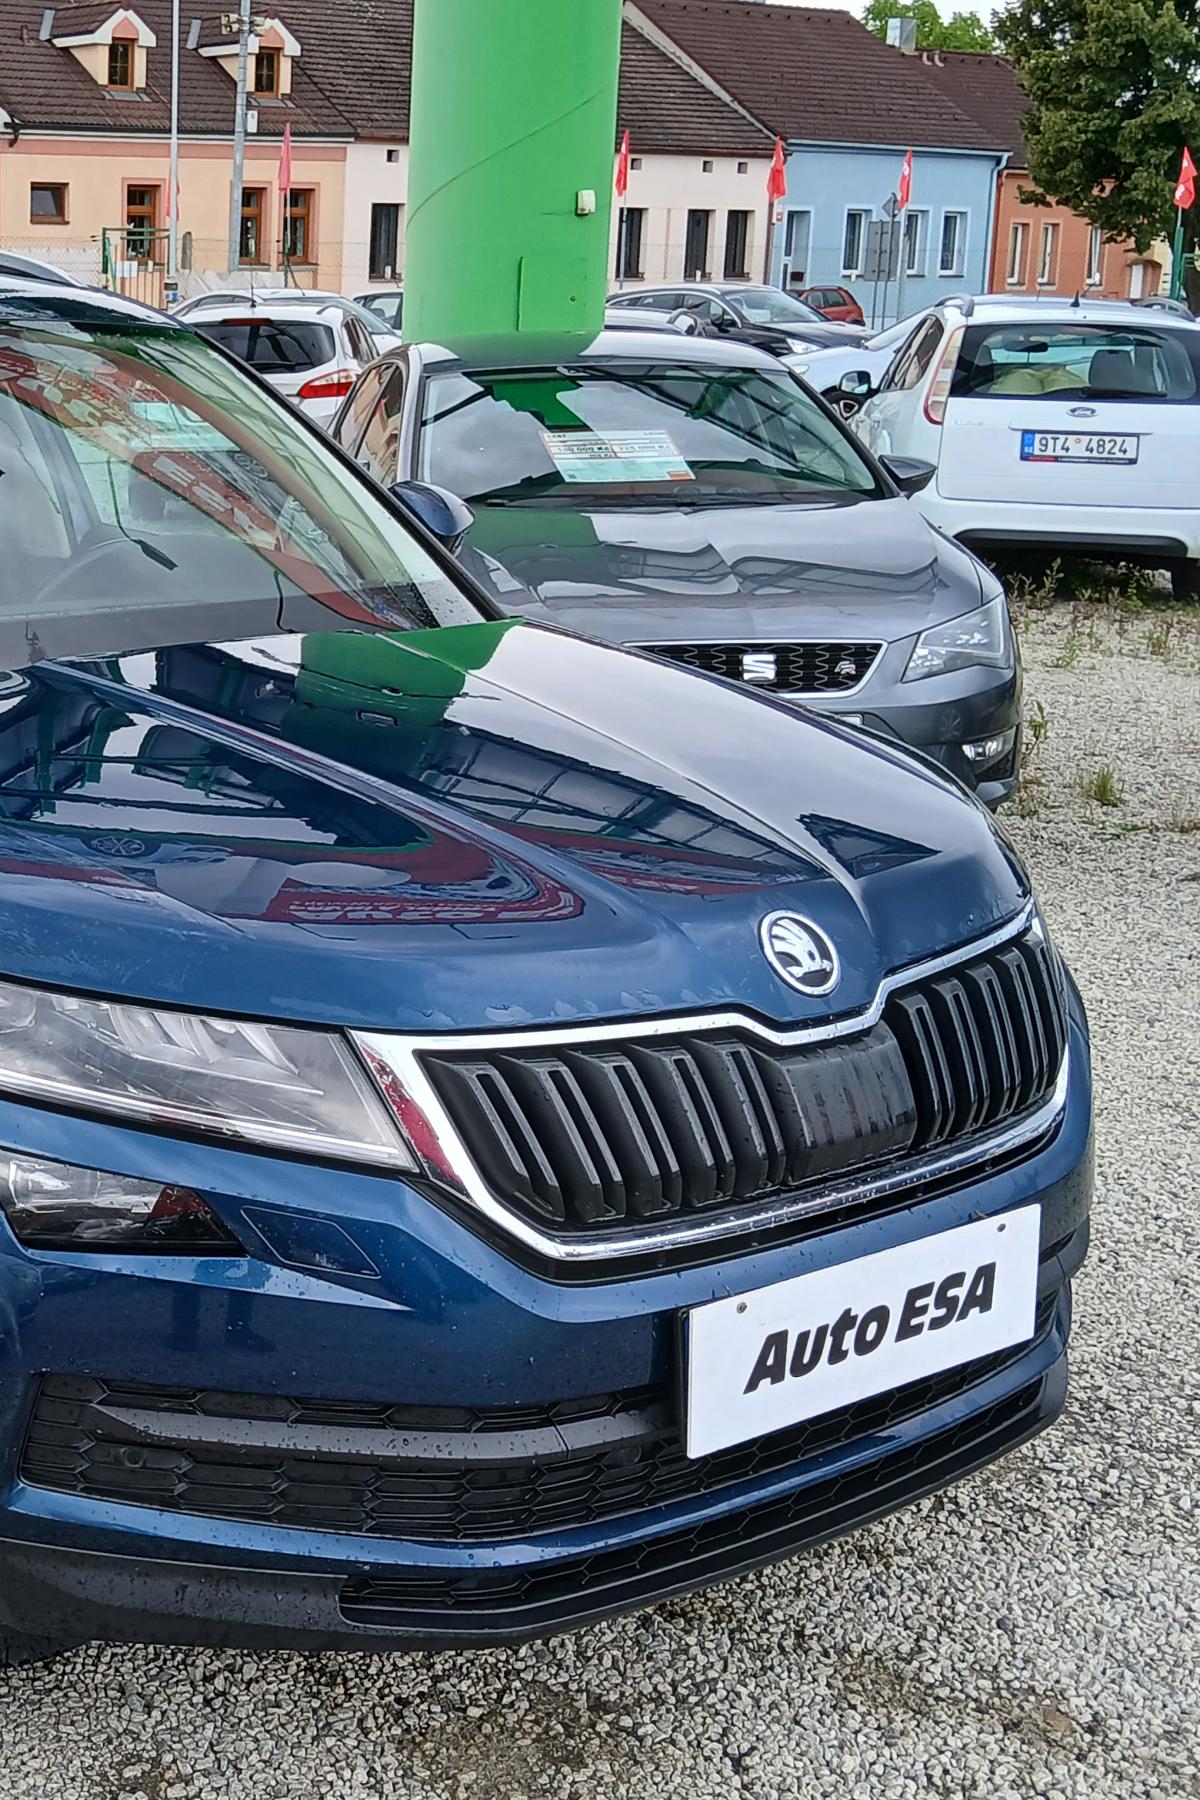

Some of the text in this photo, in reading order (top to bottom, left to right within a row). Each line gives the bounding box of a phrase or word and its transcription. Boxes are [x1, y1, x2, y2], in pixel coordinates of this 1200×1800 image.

[1038, 436, 1128, 456] 9T4 4824
[742, 1261, 997, 1396] Auto ESA
